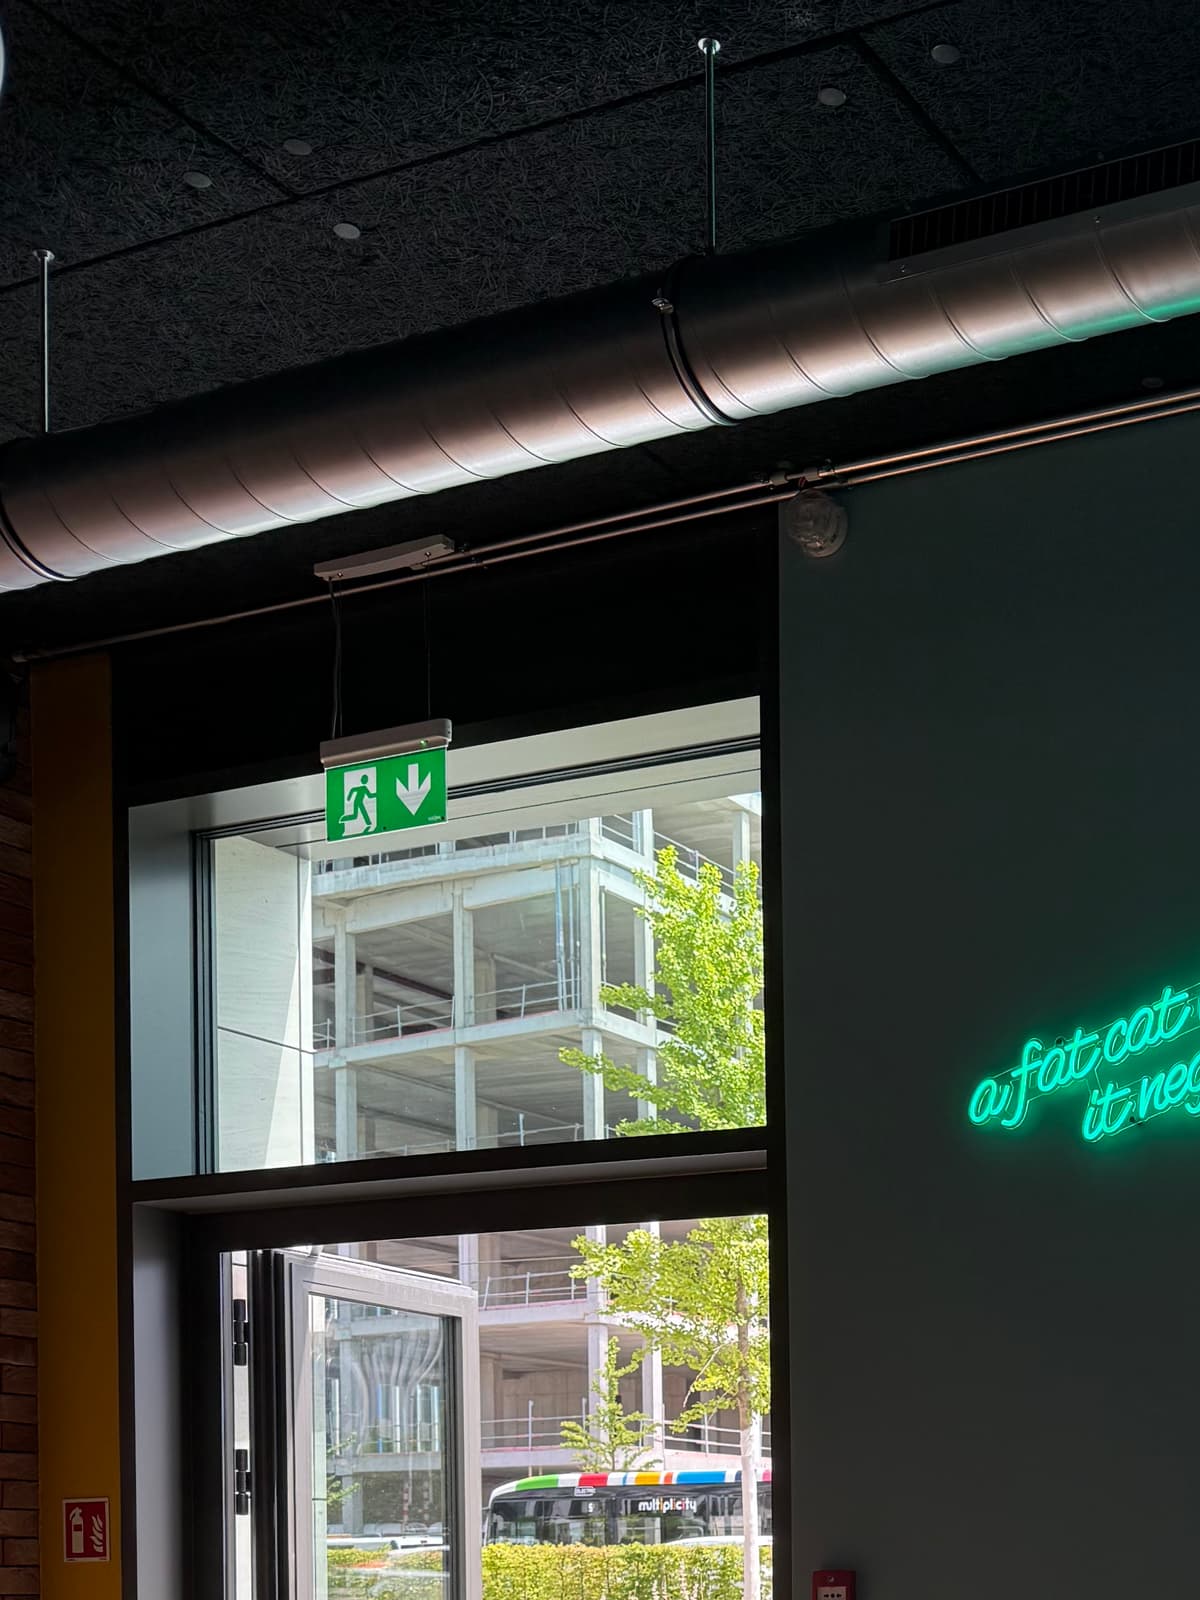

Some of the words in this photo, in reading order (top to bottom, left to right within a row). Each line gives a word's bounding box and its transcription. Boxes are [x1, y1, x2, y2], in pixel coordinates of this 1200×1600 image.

[969, 1078, 1008, 1122] a
[1001, 1029, 1100, 1128] fat
[1101, 985, 1190, 1062] cat
[1082, 1084, 1134, 1142] it
[638, 1498, 697, 1513] multiplicity
